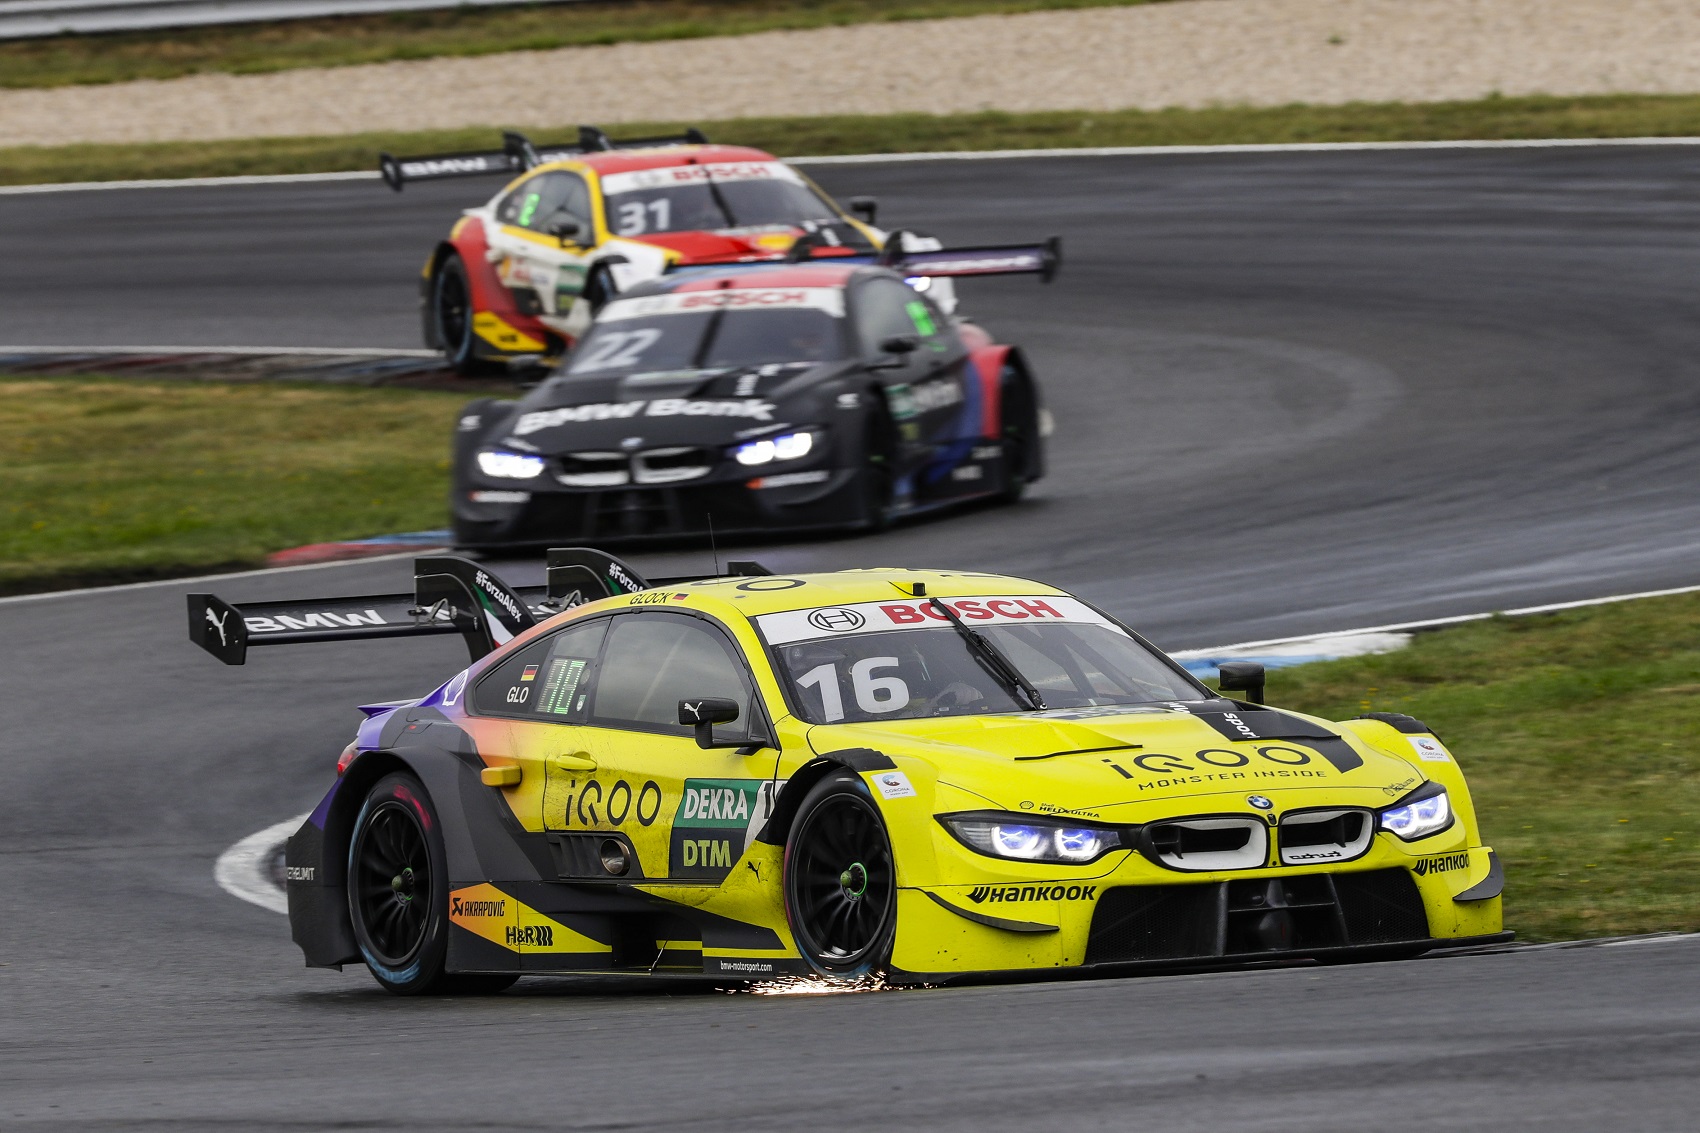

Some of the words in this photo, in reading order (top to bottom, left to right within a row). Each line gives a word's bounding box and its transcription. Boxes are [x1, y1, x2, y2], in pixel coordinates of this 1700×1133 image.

[617, 197, 671, 237] 31
[571, 327, 663, 375] 22
[513, 401, 646, 435] BMW
[646, 399, 776, 421] Bank
[475, 570, 523, 623] #ForzaAlex
[630, 592, 674, 605] GLOCK
[244, 609, 387, 632] BMW
[879, 600, 1065, 625] BOSCH
[506, 686, 530, 704] GLO
[796, 656, 910, 723] 16
[1101, 746, 1310, 779] iQOO
[1138, 772, 1246, 791] MONSTER
[1253, 770, 1327, 778] INSIDE
[565, 779, 662, 827] iQOO
[683, 788, 748, 820] DEKRA
[763, 783, 786, 820] 1
[683, 840, 731, 868] DTM
[506, 925, 536, 947] H&R
[720, 960, 773, 973] bmw-motorsport.com
